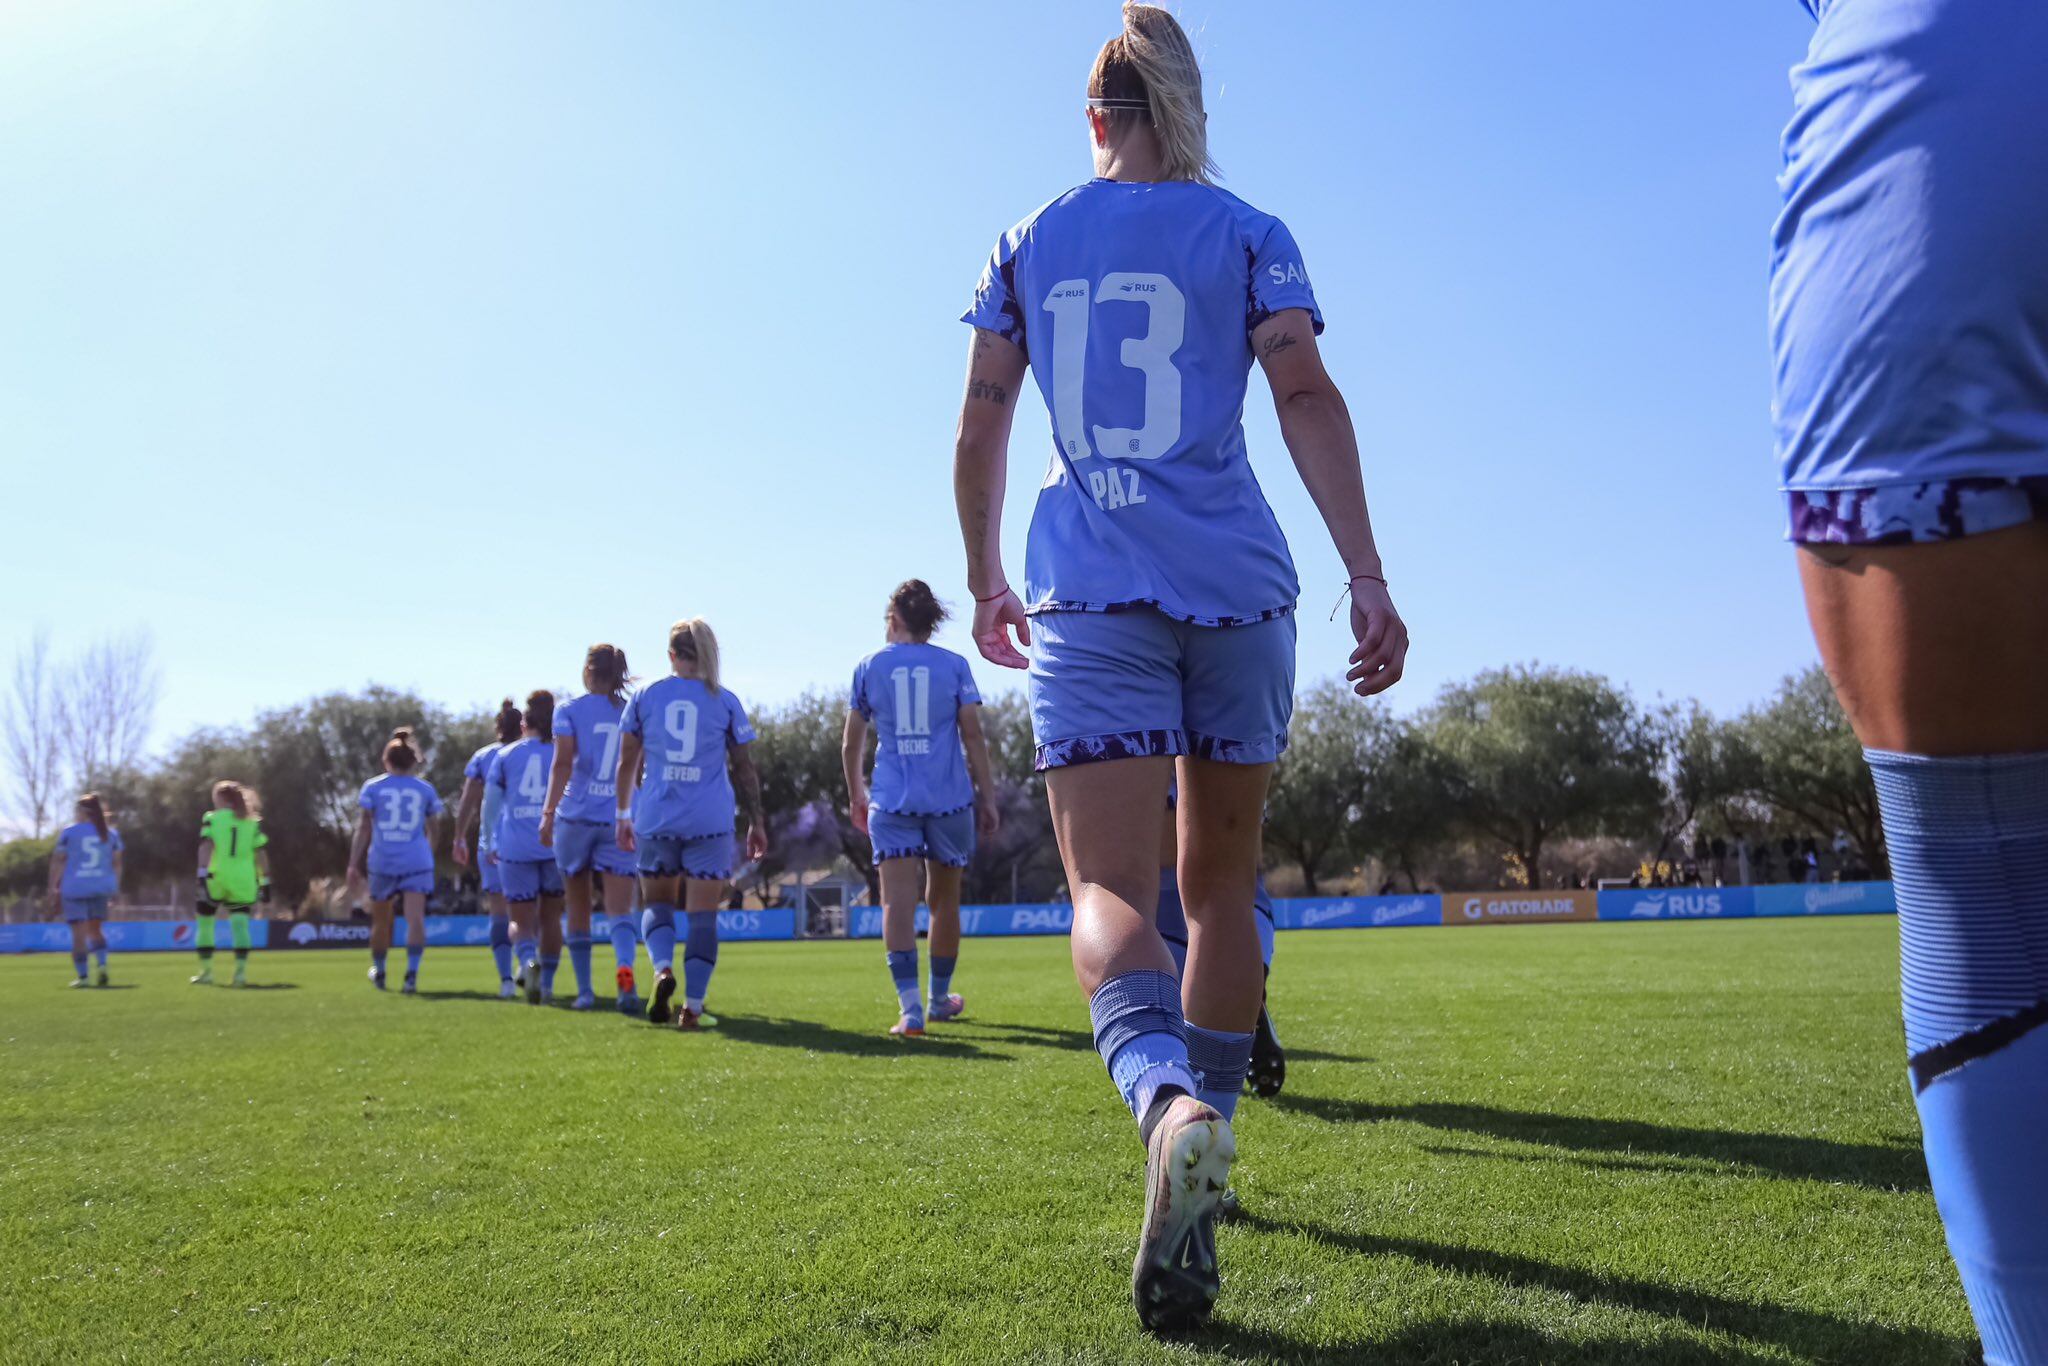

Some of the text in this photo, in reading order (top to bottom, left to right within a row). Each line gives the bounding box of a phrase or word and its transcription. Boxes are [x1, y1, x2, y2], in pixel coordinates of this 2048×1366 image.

[1065, 289, 1085, 298] RUS
[1134, 283, 1157, 293] RUS
[1042, 272, 1186, 461] 13
[1088, 466, 1147, 511] PAZ
[890, 665, 931, 736] 11
[664, 699, 699, 764] 9
[593, 722, 620, 781] 7
[518, 753, 546, 803] 4
[378, 787, 422, 832] 33
[80, 835, 101, 869] 5
[230, 826, 238, 857] 1
[1463, 898, 1575, 919] G GATORADE
[1668, 894, 1722, 915] RUS
[318, 924, 371, 941] Macro
